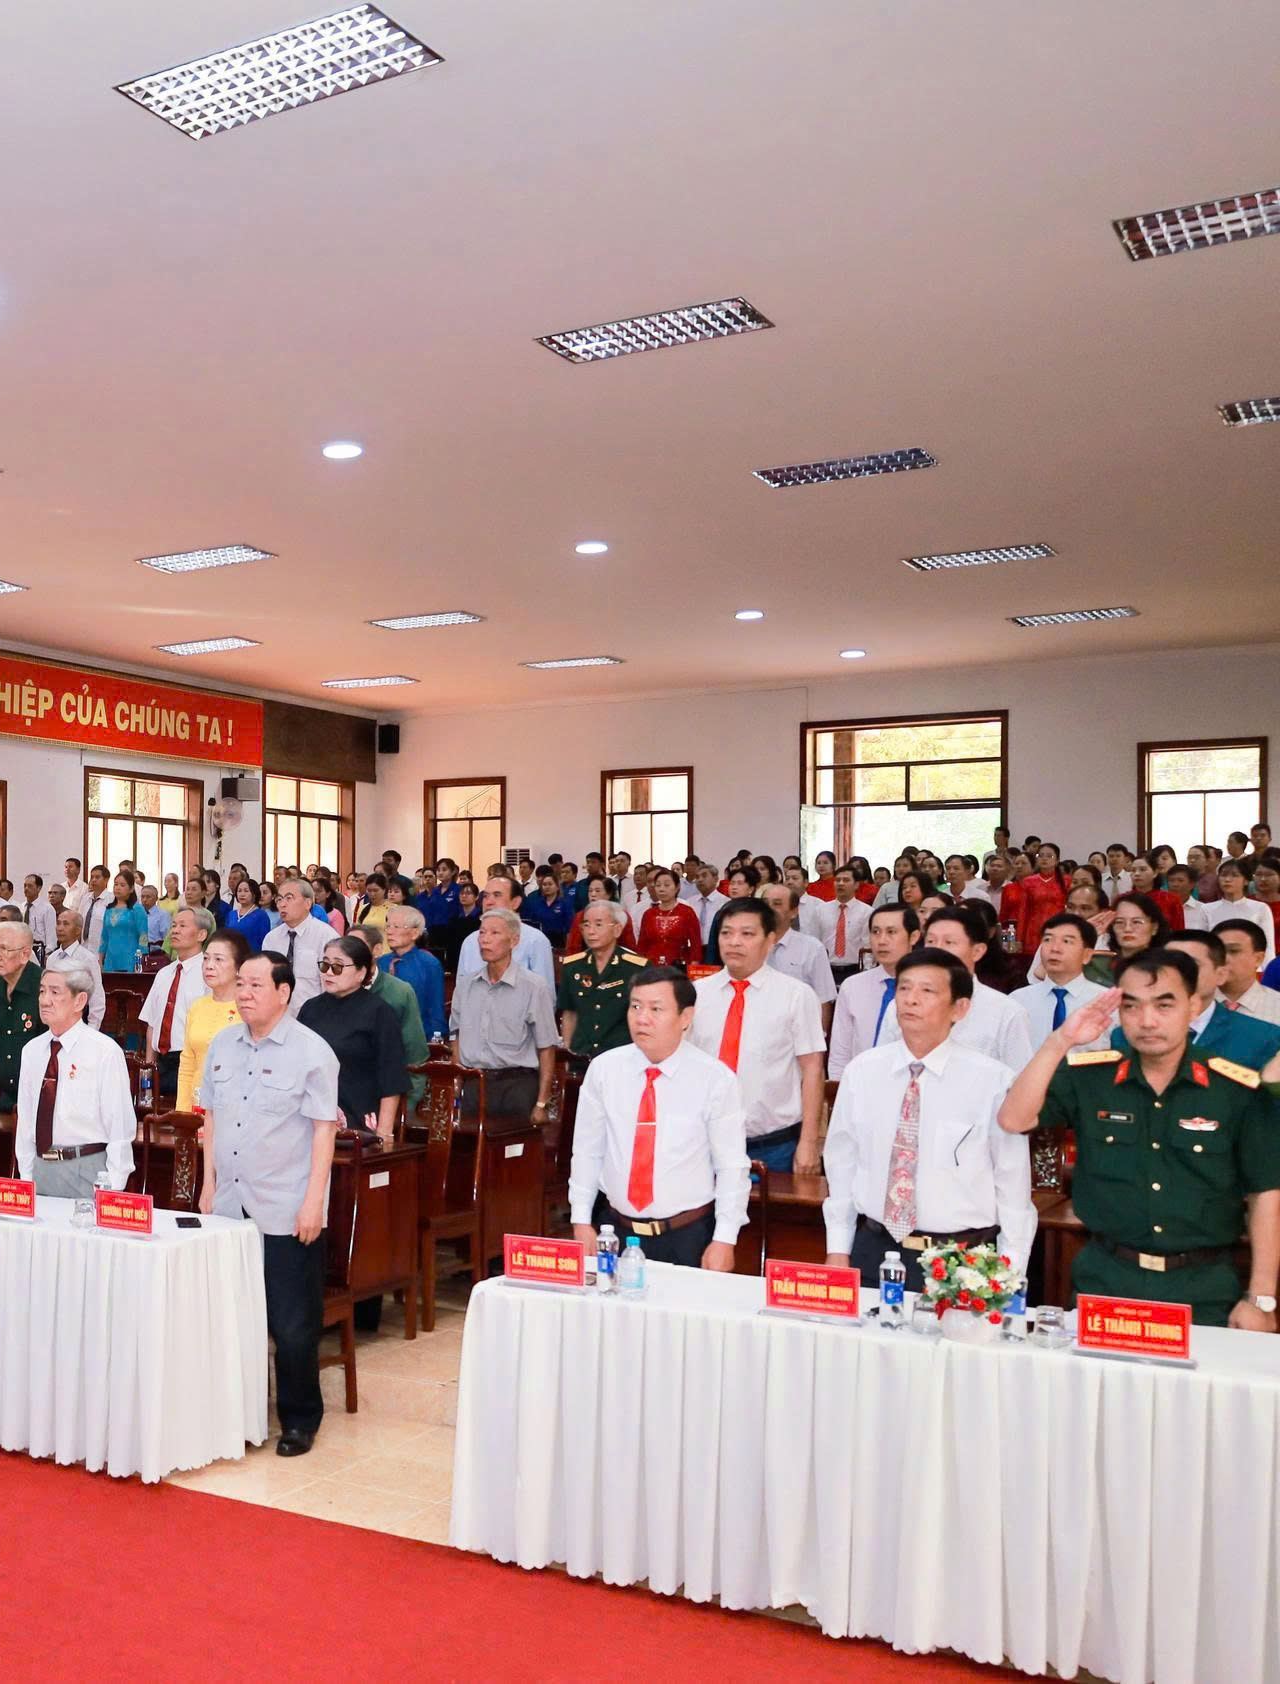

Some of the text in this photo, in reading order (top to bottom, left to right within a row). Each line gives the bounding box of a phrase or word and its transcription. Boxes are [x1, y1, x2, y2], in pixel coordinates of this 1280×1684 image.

[60, 683, 109, 729] CỦA
[114, 697, 191, 741] CHÚNG
[196, 713, 223, 746] TA
